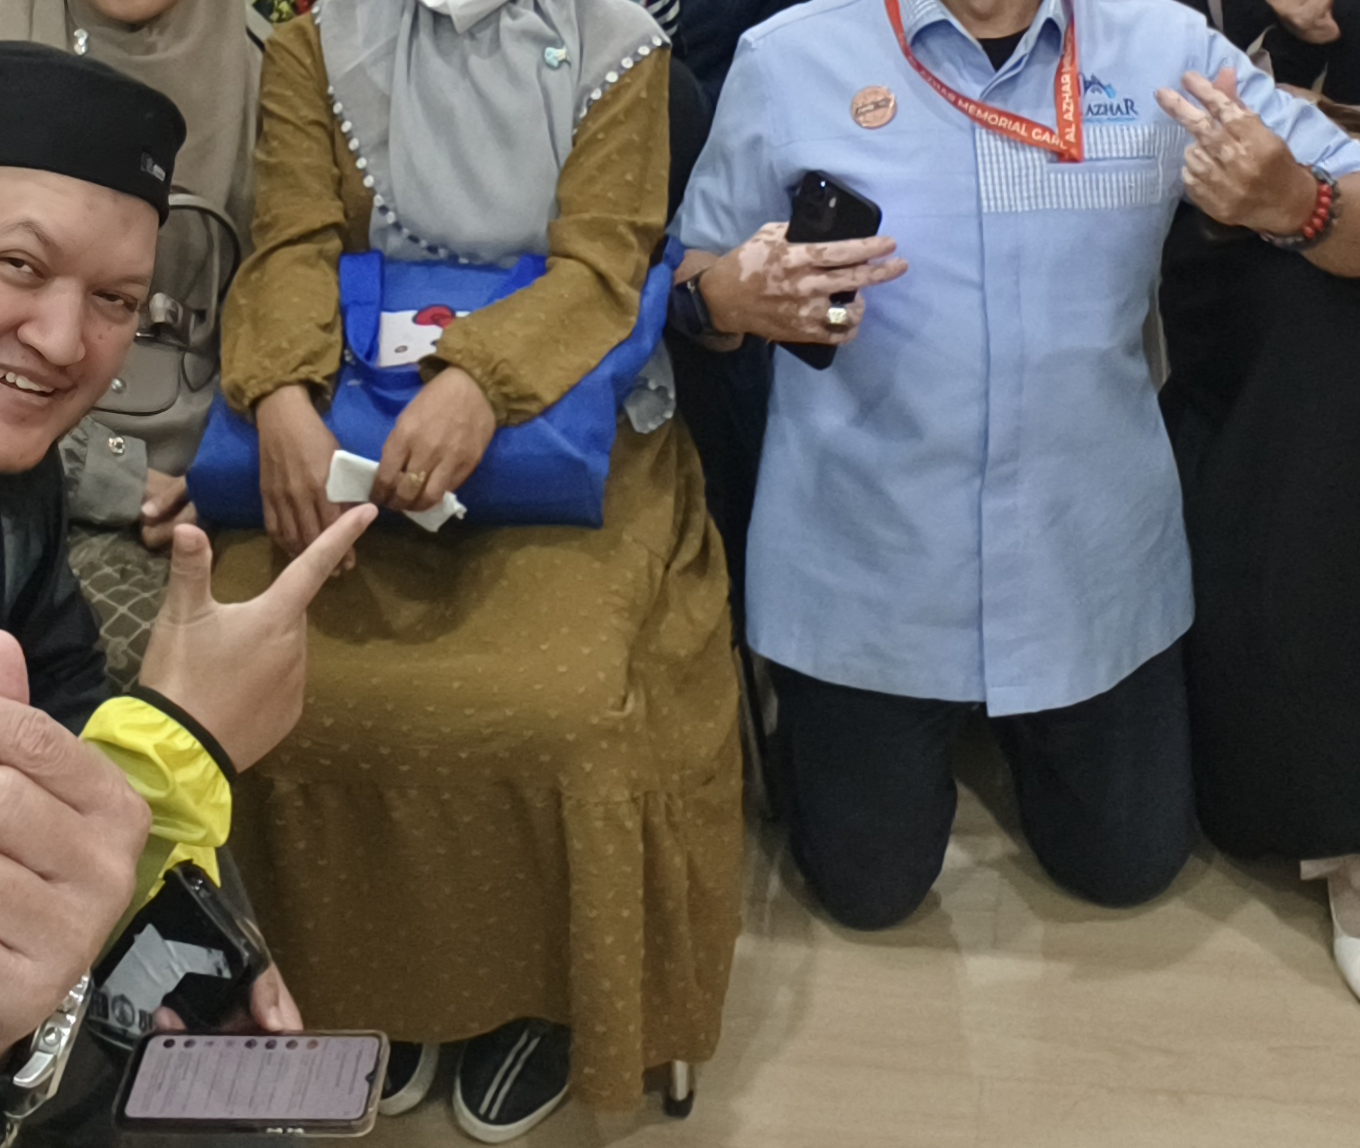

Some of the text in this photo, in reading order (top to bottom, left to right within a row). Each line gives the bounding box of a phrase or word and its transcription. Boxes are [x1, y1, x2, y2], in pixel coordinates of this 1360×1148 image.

[1060, 73, 1075, 122] AZHAR
[1085, 98, 1138, 117] AZHAR
[957, 97, 1028, 138] MEMORIAL
[1065, 123, 1076, 143] AL
